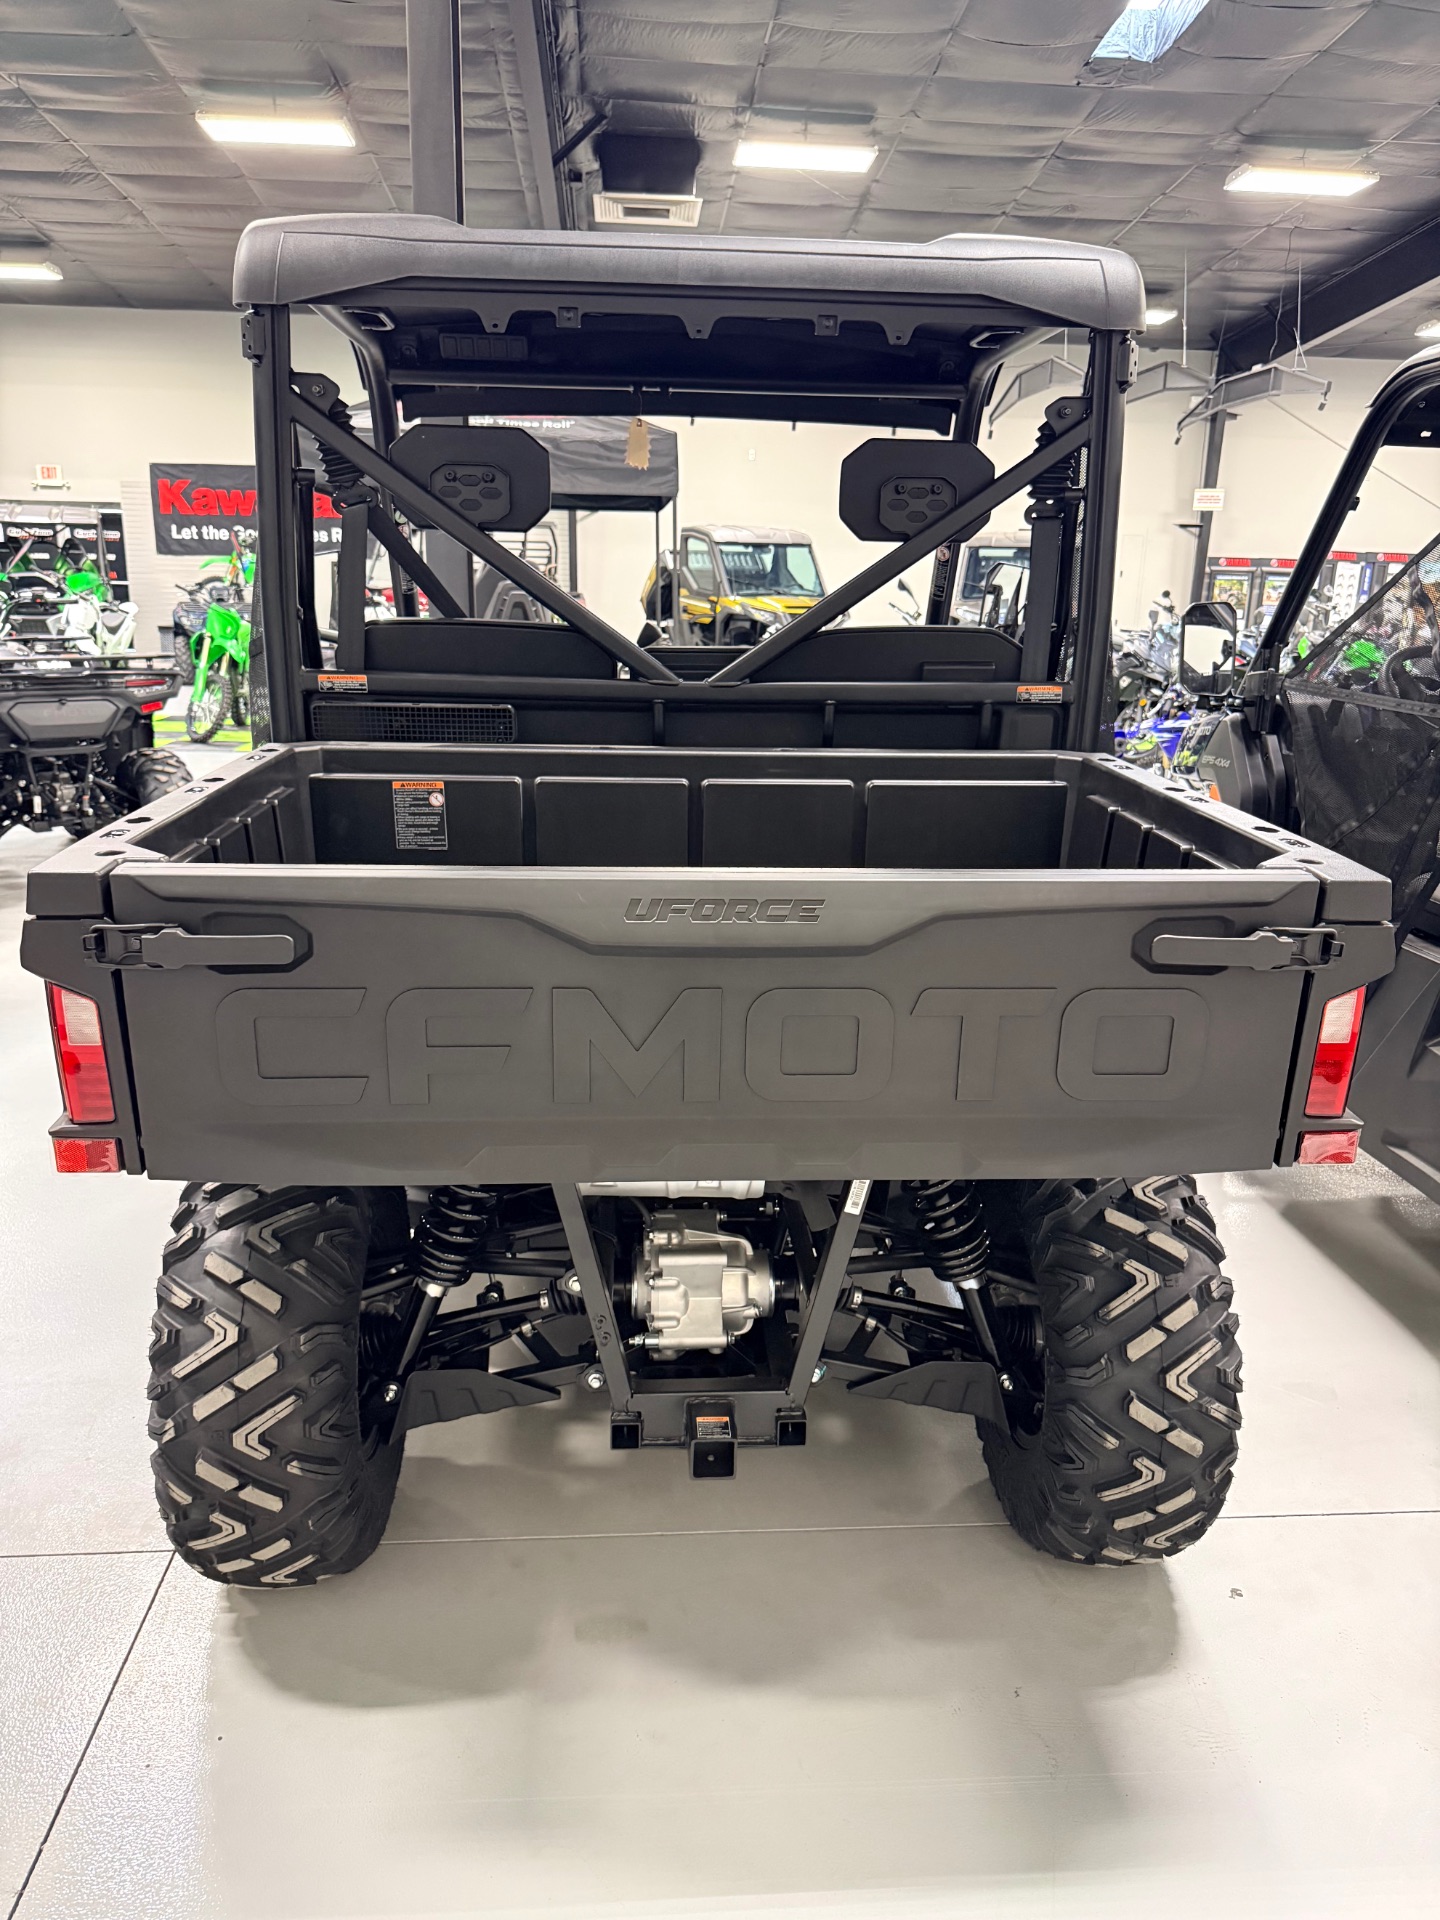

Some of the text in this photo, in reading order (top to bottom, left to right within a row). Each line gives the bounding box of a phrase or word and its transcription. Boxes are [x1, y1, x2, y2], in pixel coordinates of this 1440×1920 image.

[496, 418, 540, 428] Times
[41, 466, 57, 479] EXIT
[171, 524, 198, 540] Let
[201, 525, 230, 540] the
[1332, 552, 1357, 561] YAMAHA
[1384, 553, 1409, 562] YAMAHA
[1226, 559, 1252, 567] YAMAHA
[1215, 757, 1231, 768] 4X4
[624, 898, 826, 923] UFORCE
[215, 986, 1212, 1106] CFMOTO
